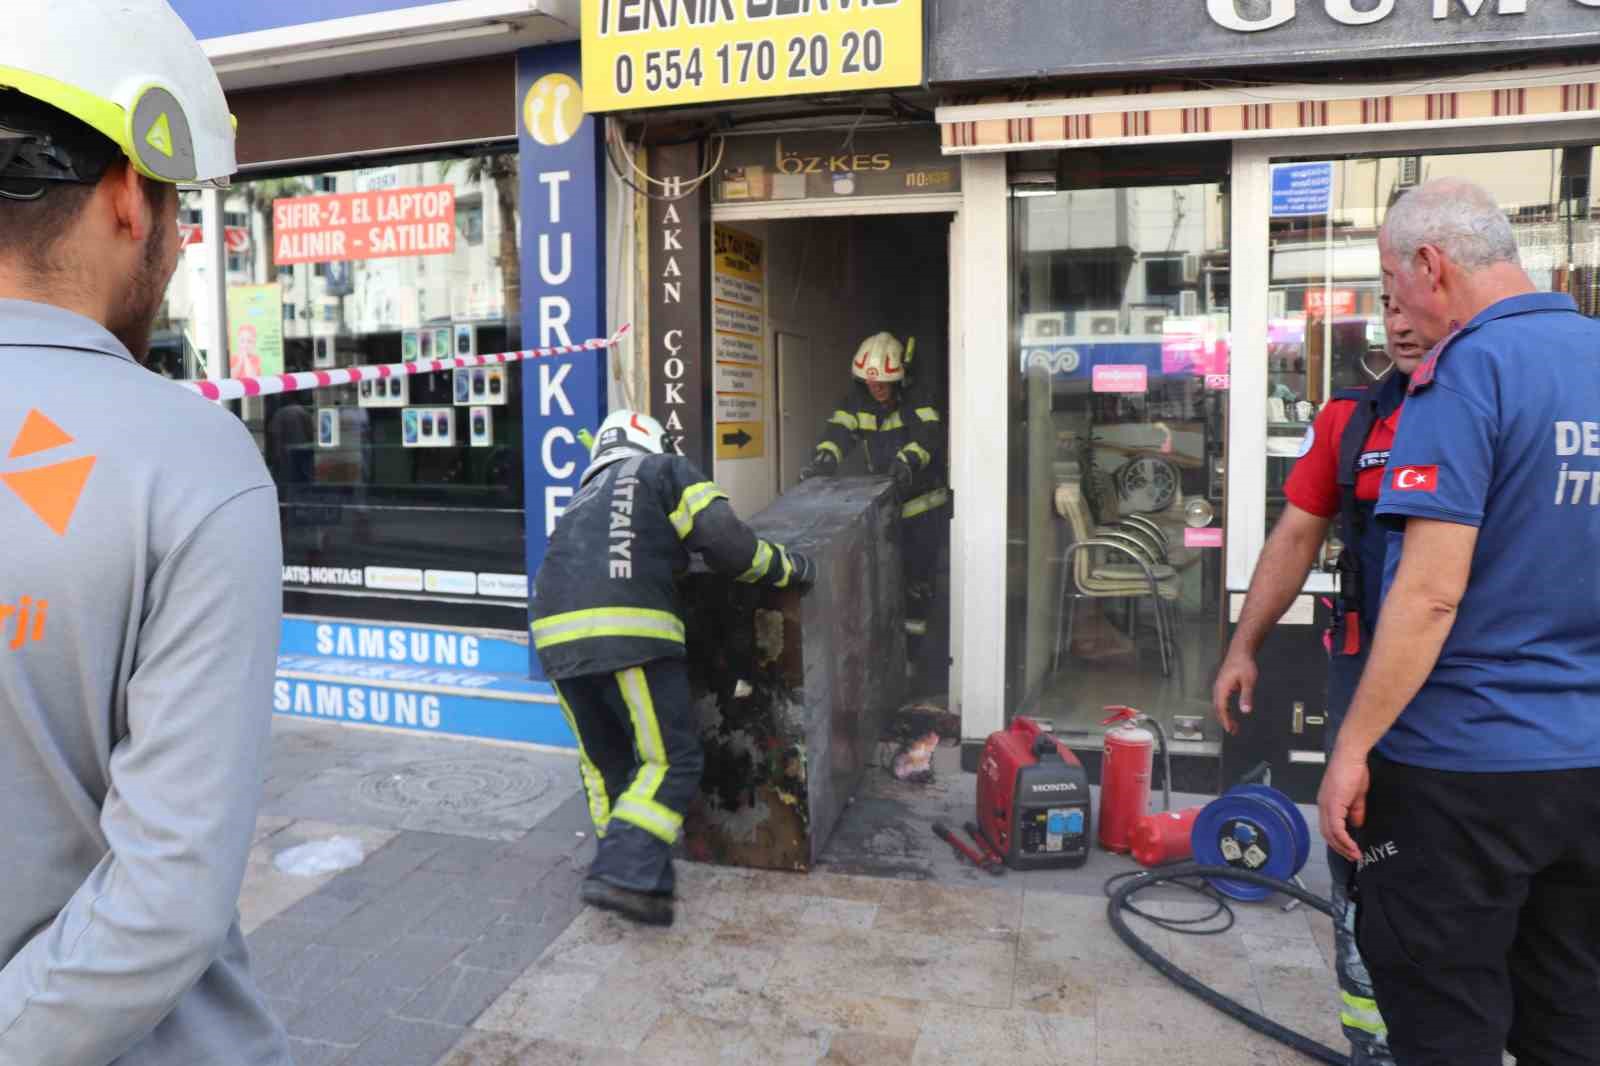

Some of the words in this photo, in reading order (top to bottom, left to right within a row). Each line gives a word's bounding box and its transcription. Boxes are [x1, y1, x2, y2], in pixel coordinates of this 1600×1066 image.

[616, 54, 633, 94] 0
[645, 47, 703, 91] 554
[716, 40, 775, 84] 170
[787, 34, 828, 78] 20
[841, 29, 883, 73] 20
[352, 198, 372, 224] EL
[377, 191, 451, 221] LAPTOP
[278, 231, 346, 259] ALINIR
[368, 222, 450, 251] SATILIR
[662, 176, 682, 303] HAKAN
[1555, 420, 1600, 456] DE
[609, 475, 641, 579] İTFAİYE
[281, 566, 310, 585] ATIŞ
[311, 567, 363, 586] NOKTASI
[316, 624, 480, 667] SAMSUNG
[273, 680, 440, 728] SAMSUNG
[1032, 782, 1077, 793] HONDA
